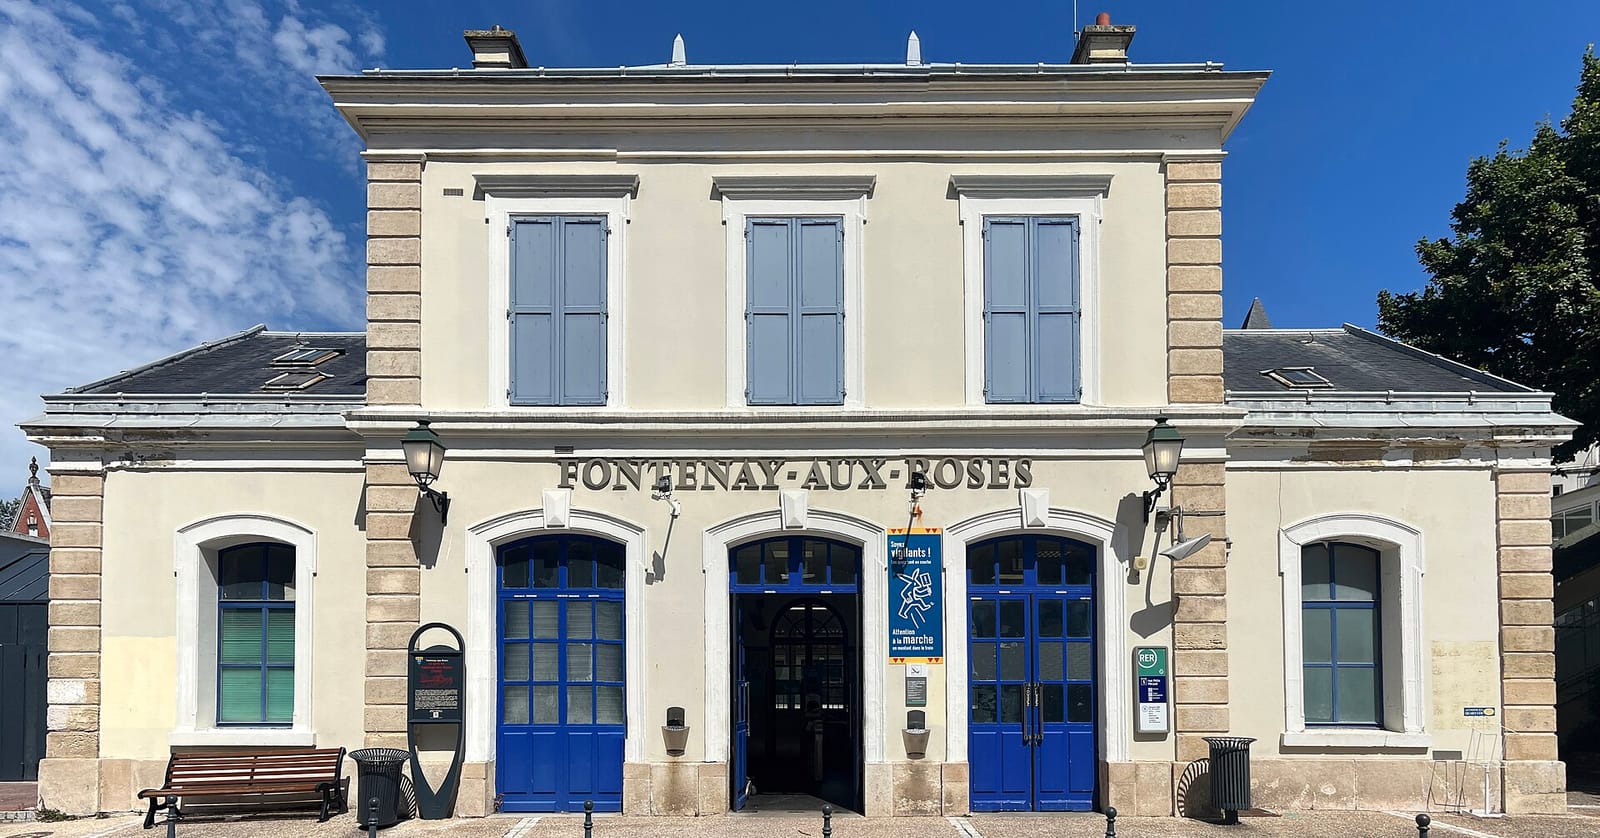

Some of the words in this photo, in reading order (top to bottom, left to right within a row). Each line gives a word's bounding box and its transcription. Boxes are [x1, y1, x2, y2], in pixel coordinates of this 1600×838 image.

[558, 457, 1033, 491] FONTENAY-AUX-ROSES
[891, 547, 926, 560] vigilants
[903, 634, 934, 645] marche
[1139, 653, 1155, 663] RER
